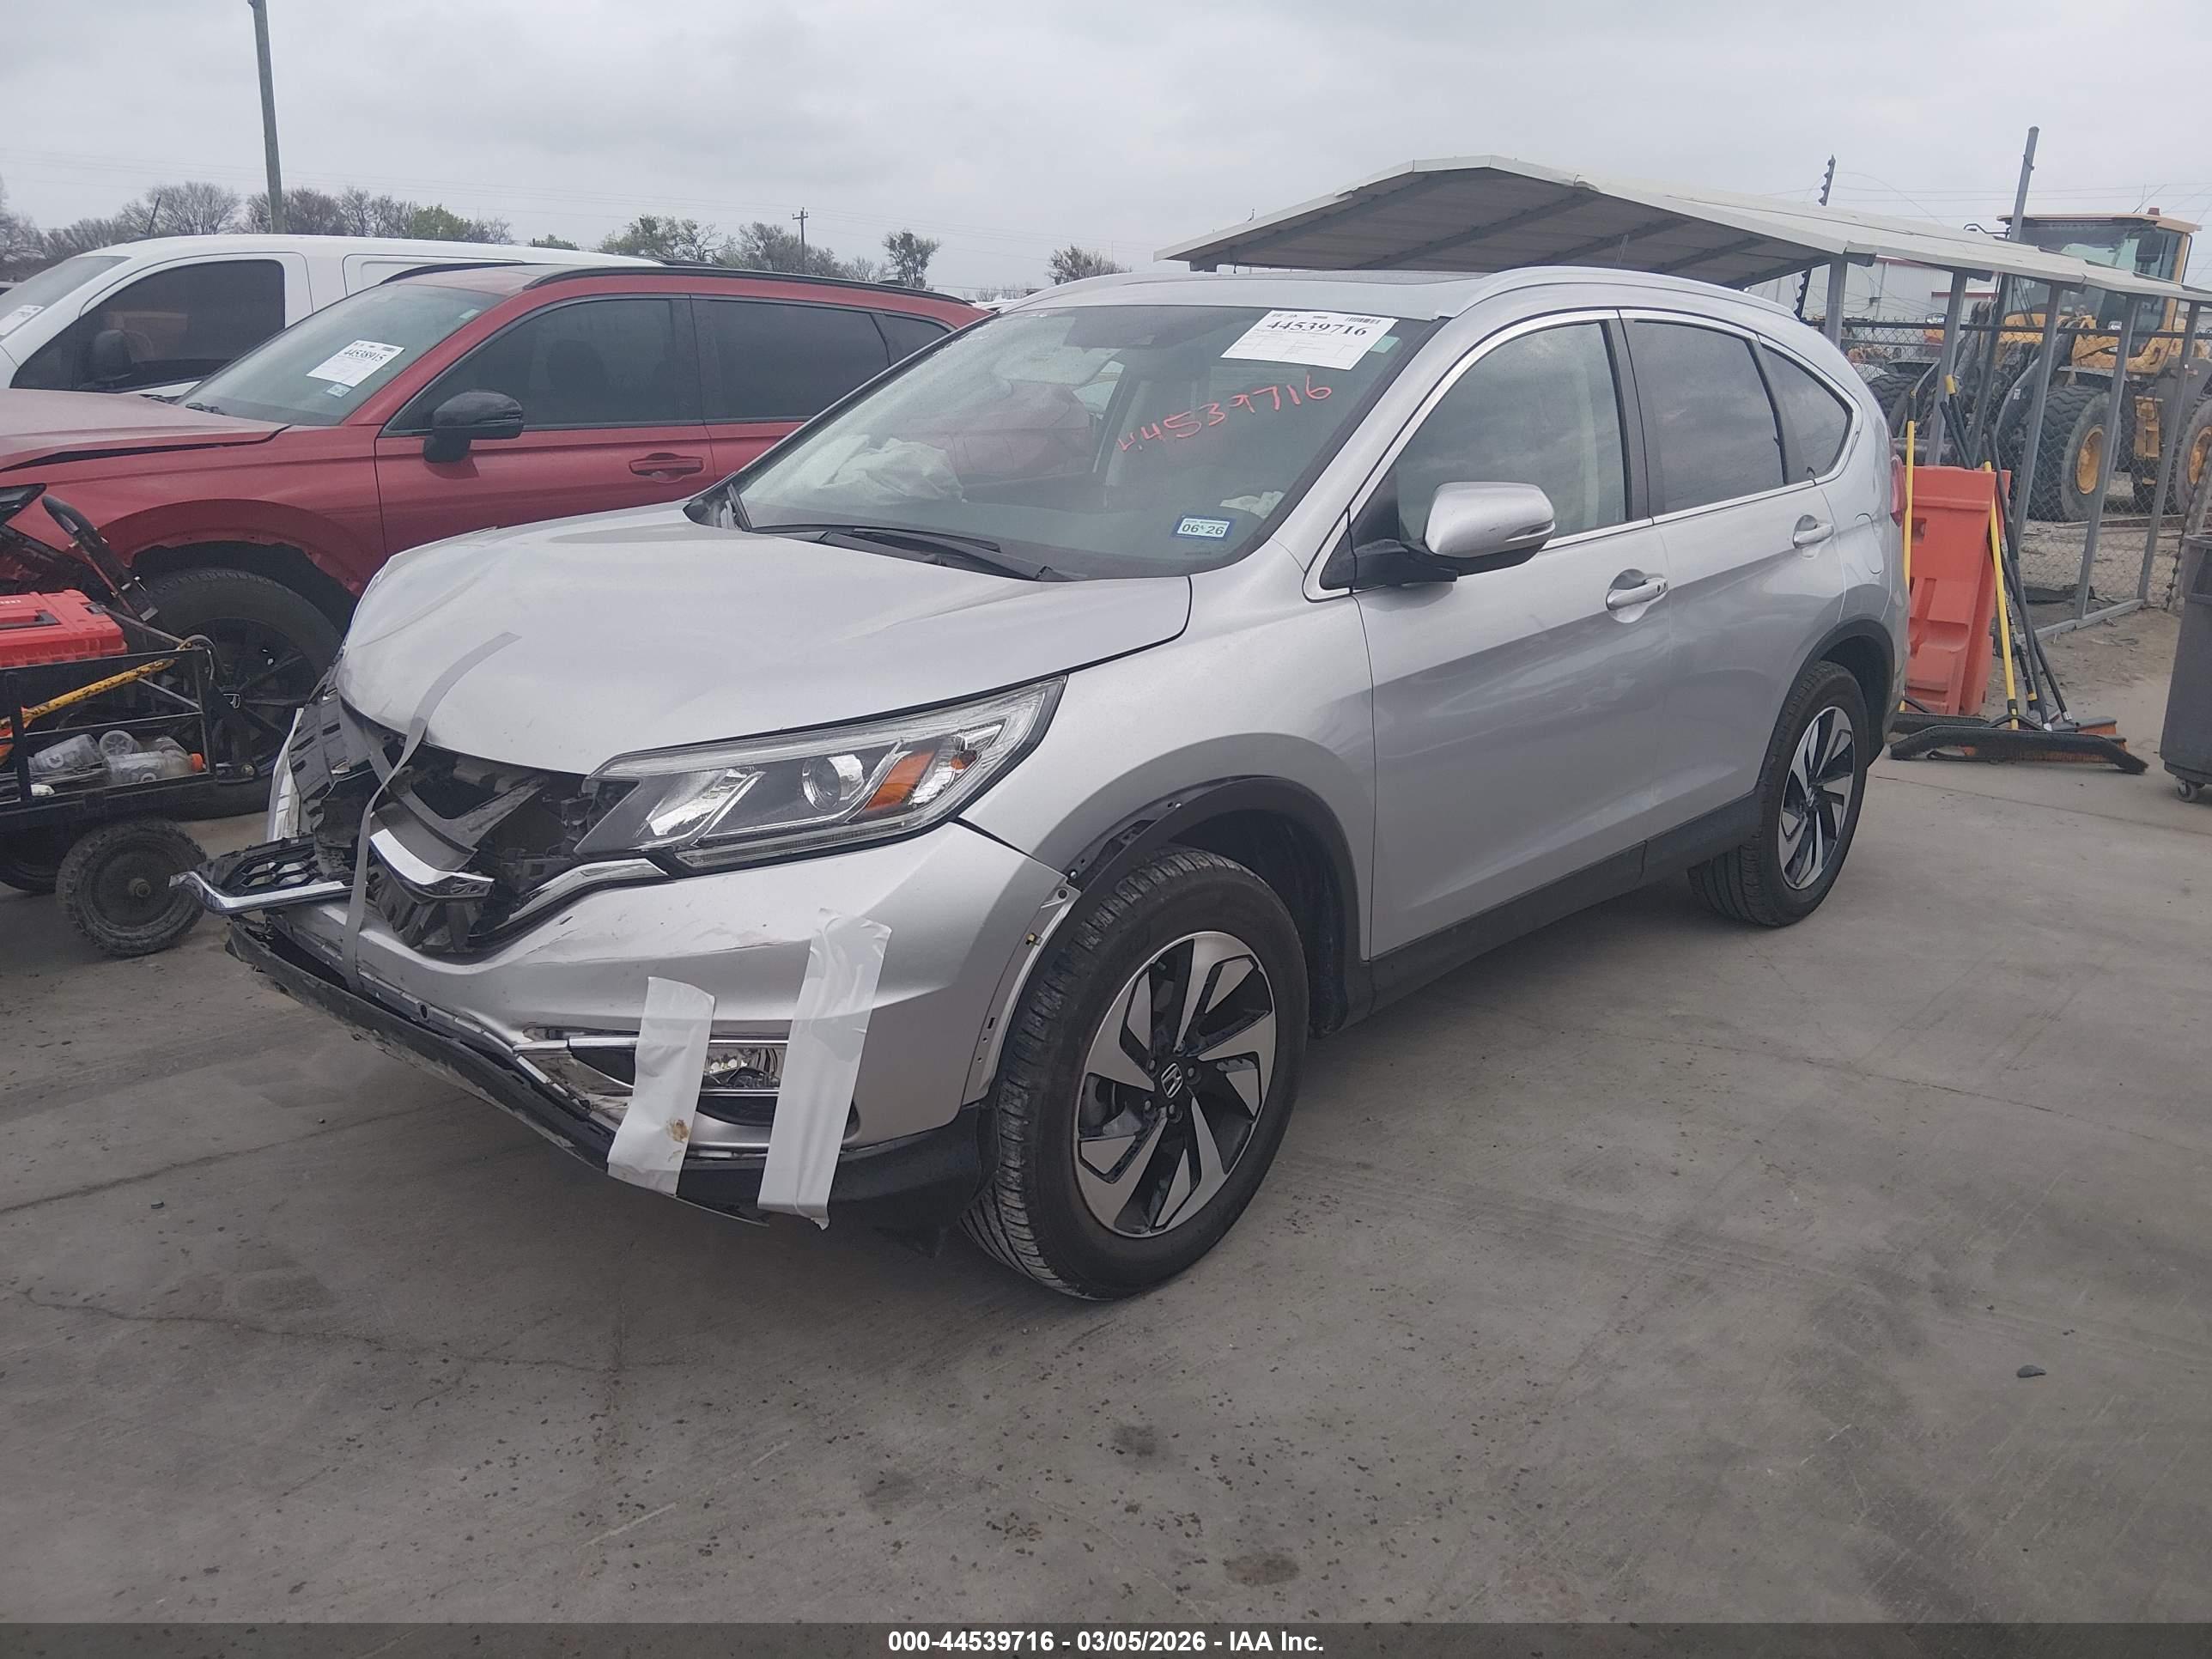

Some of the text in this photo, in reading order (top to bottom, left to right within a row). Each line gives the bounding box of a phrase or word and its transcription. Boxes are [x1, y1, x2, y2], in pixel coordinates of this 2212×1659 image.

[1267, 320, 1369, 337] 44539716
[1182, 524, 1224, 534] 06 26
